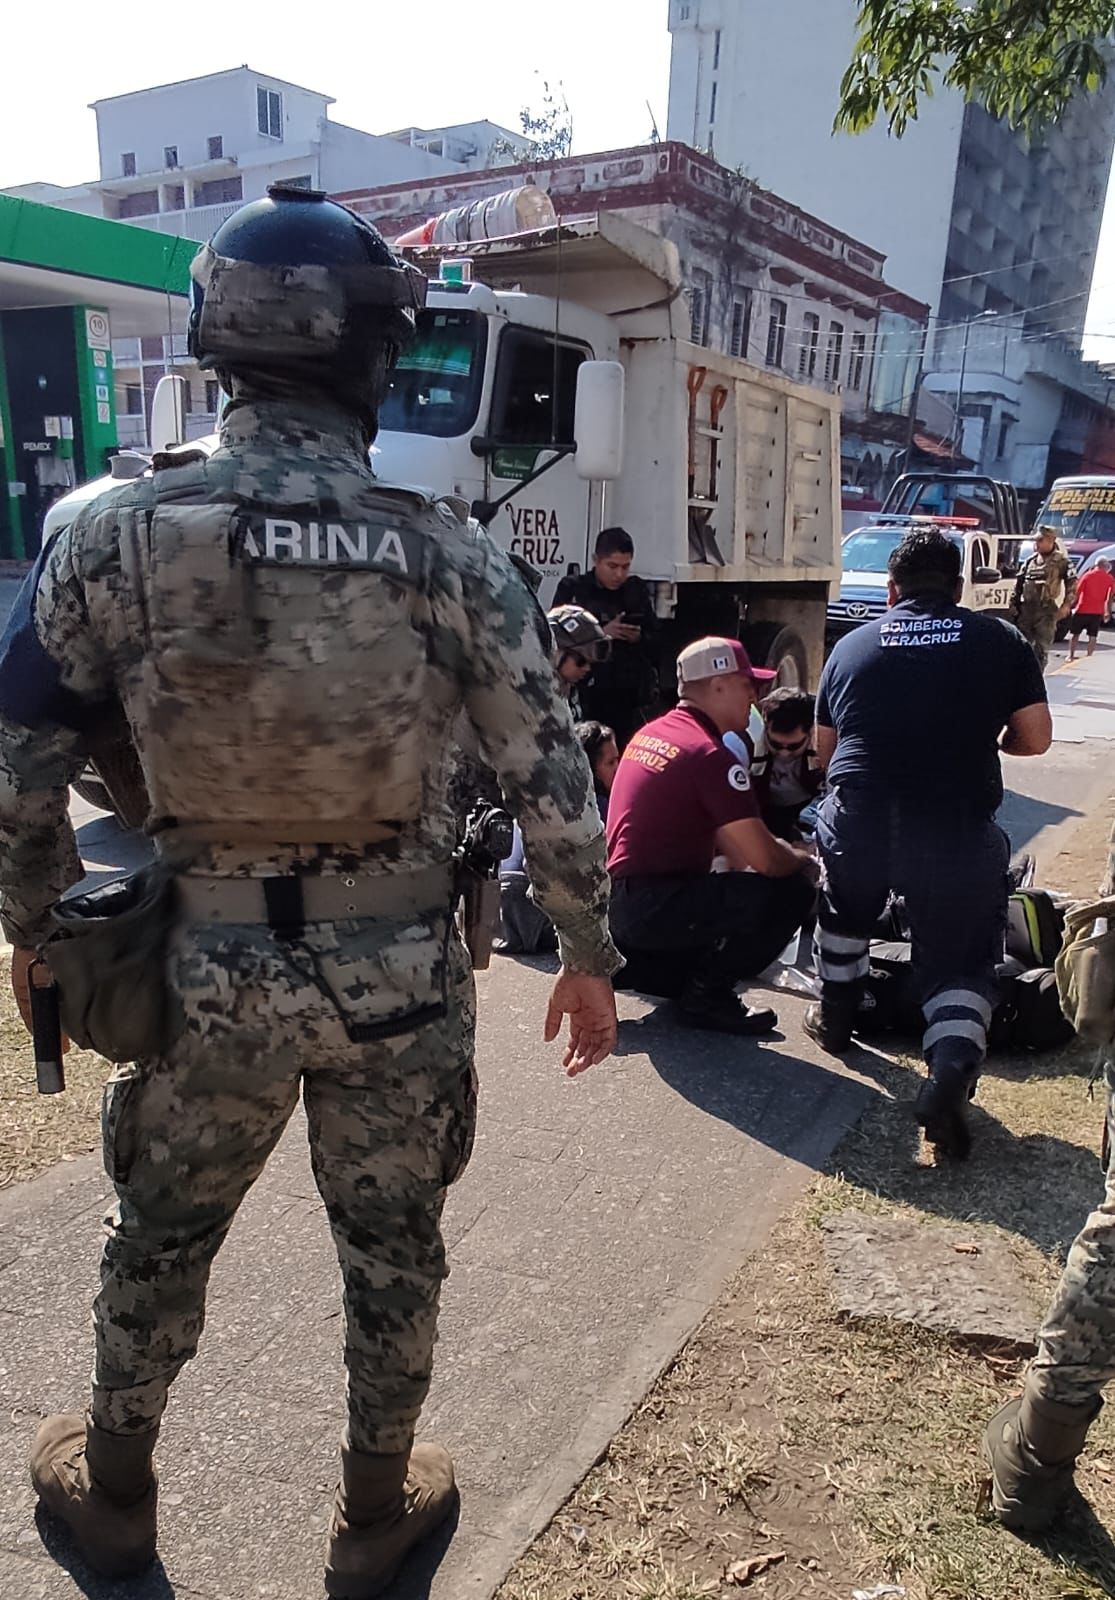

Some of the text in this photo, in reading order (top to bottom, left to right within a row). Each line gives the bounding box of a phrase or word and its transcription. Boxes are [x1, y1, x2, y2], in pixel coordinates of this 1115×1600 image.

[93, 319, 103, 328] 10
[1051, 489, 1115, 504] PALMIT
[505, 502, 559, 537] VERA
[244, 518, 409, 574] ARINA
[511, 538, 565, 565] CRUZ
[880, 618, 963, 634] BOMBEROS
[880, 632, 961, 647] VERACRUZ
